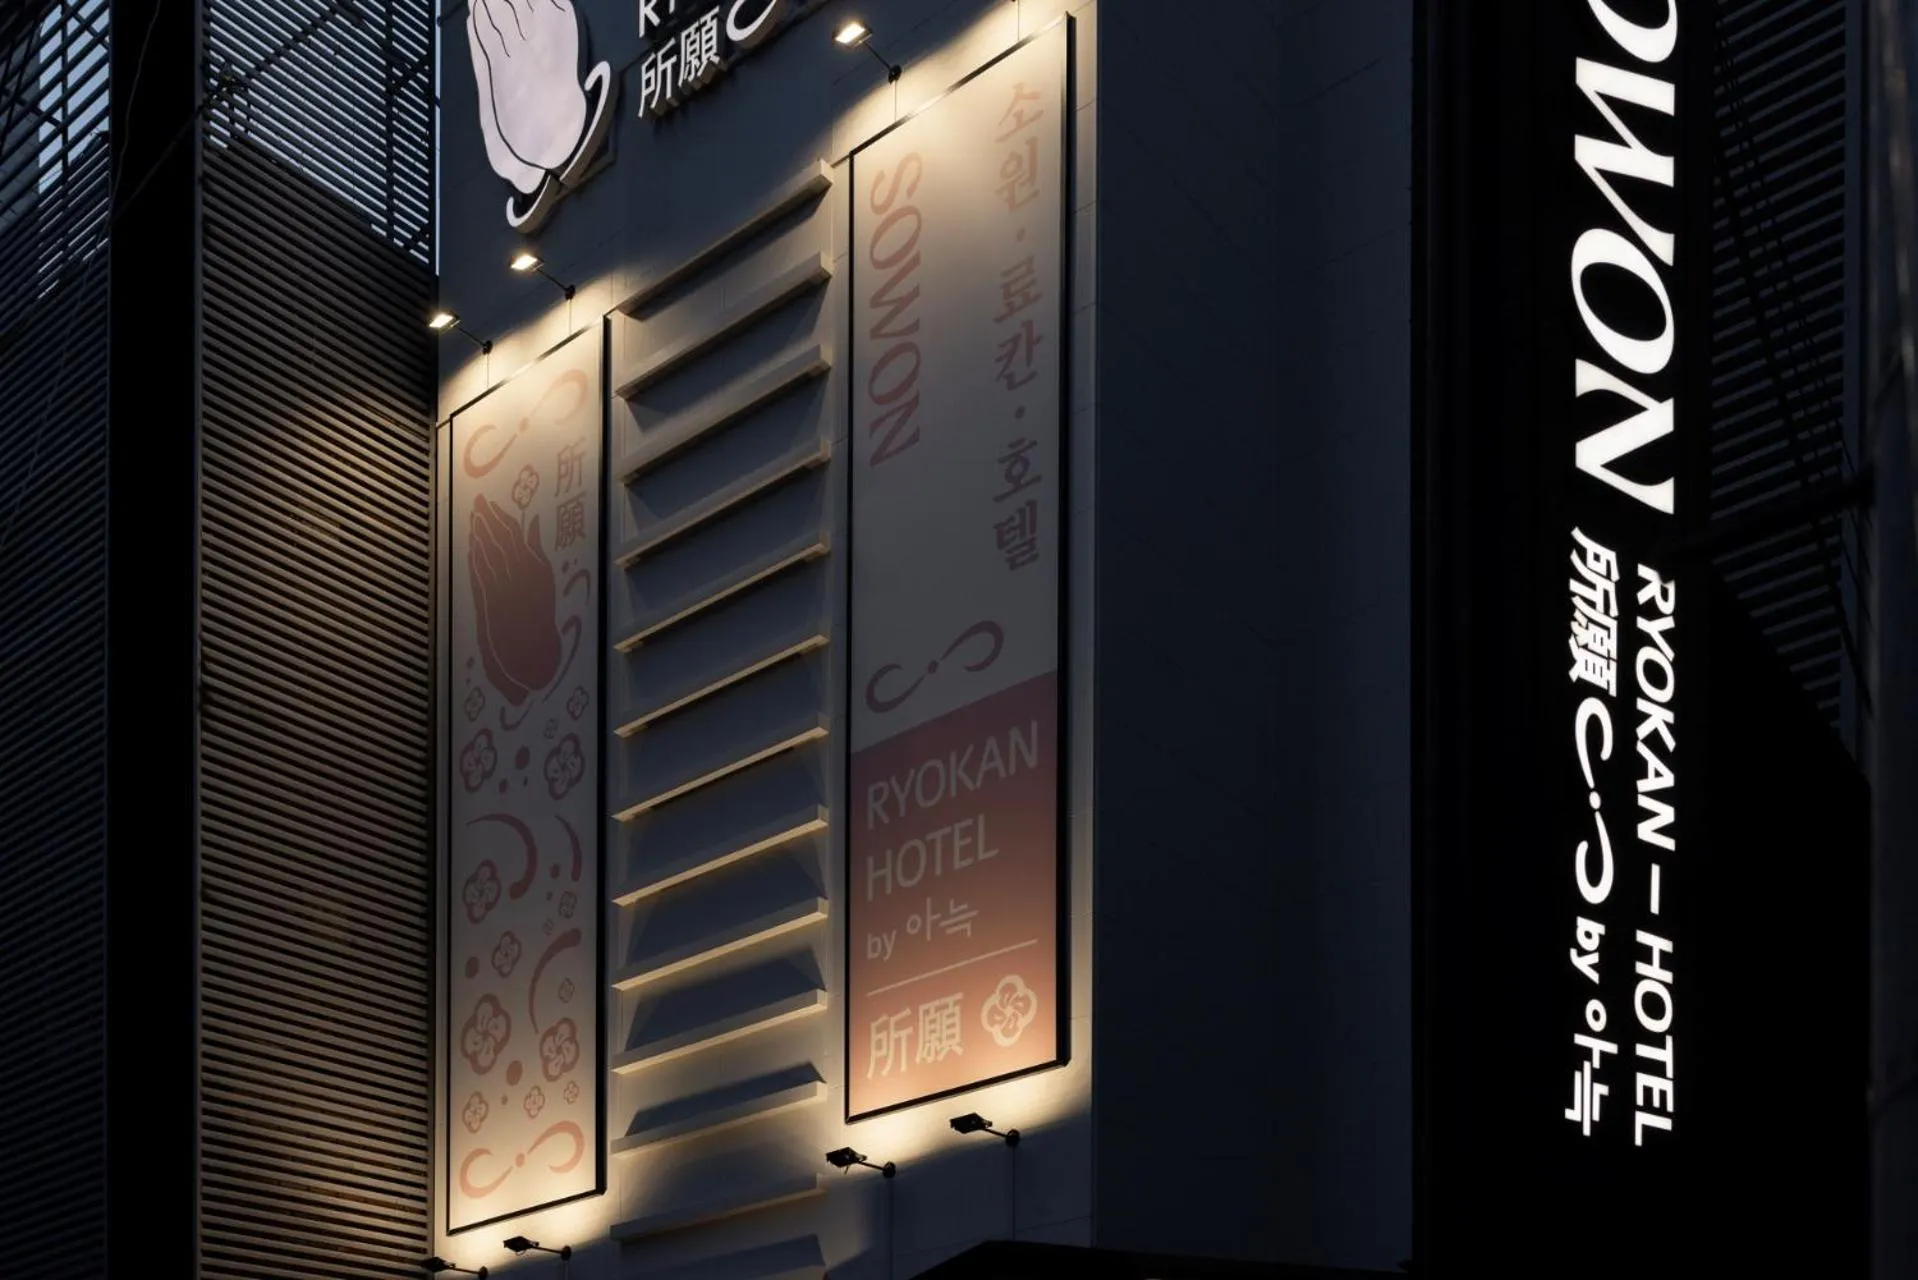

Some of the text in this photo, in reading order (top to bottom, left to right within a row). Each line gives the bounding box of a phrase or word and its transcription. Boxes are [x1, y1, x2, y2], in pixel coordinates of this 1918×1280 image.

[637, 5, 721, 118] 所願
[868, 152, 923, 468] SOWON
[1635, 562, 1676, 852] RYOKAN
[867, 720, 1038, 829] RYOKAN
[866, 814, 1000, 901] HOTEL
[1564, 526, 1620, 1137] 所願 by 아늑
[866, 897, 979, 962] by 아늑
[866, 992, 965, 1081] 所願
[1633, 928, 1674, 1147] HOTEL
